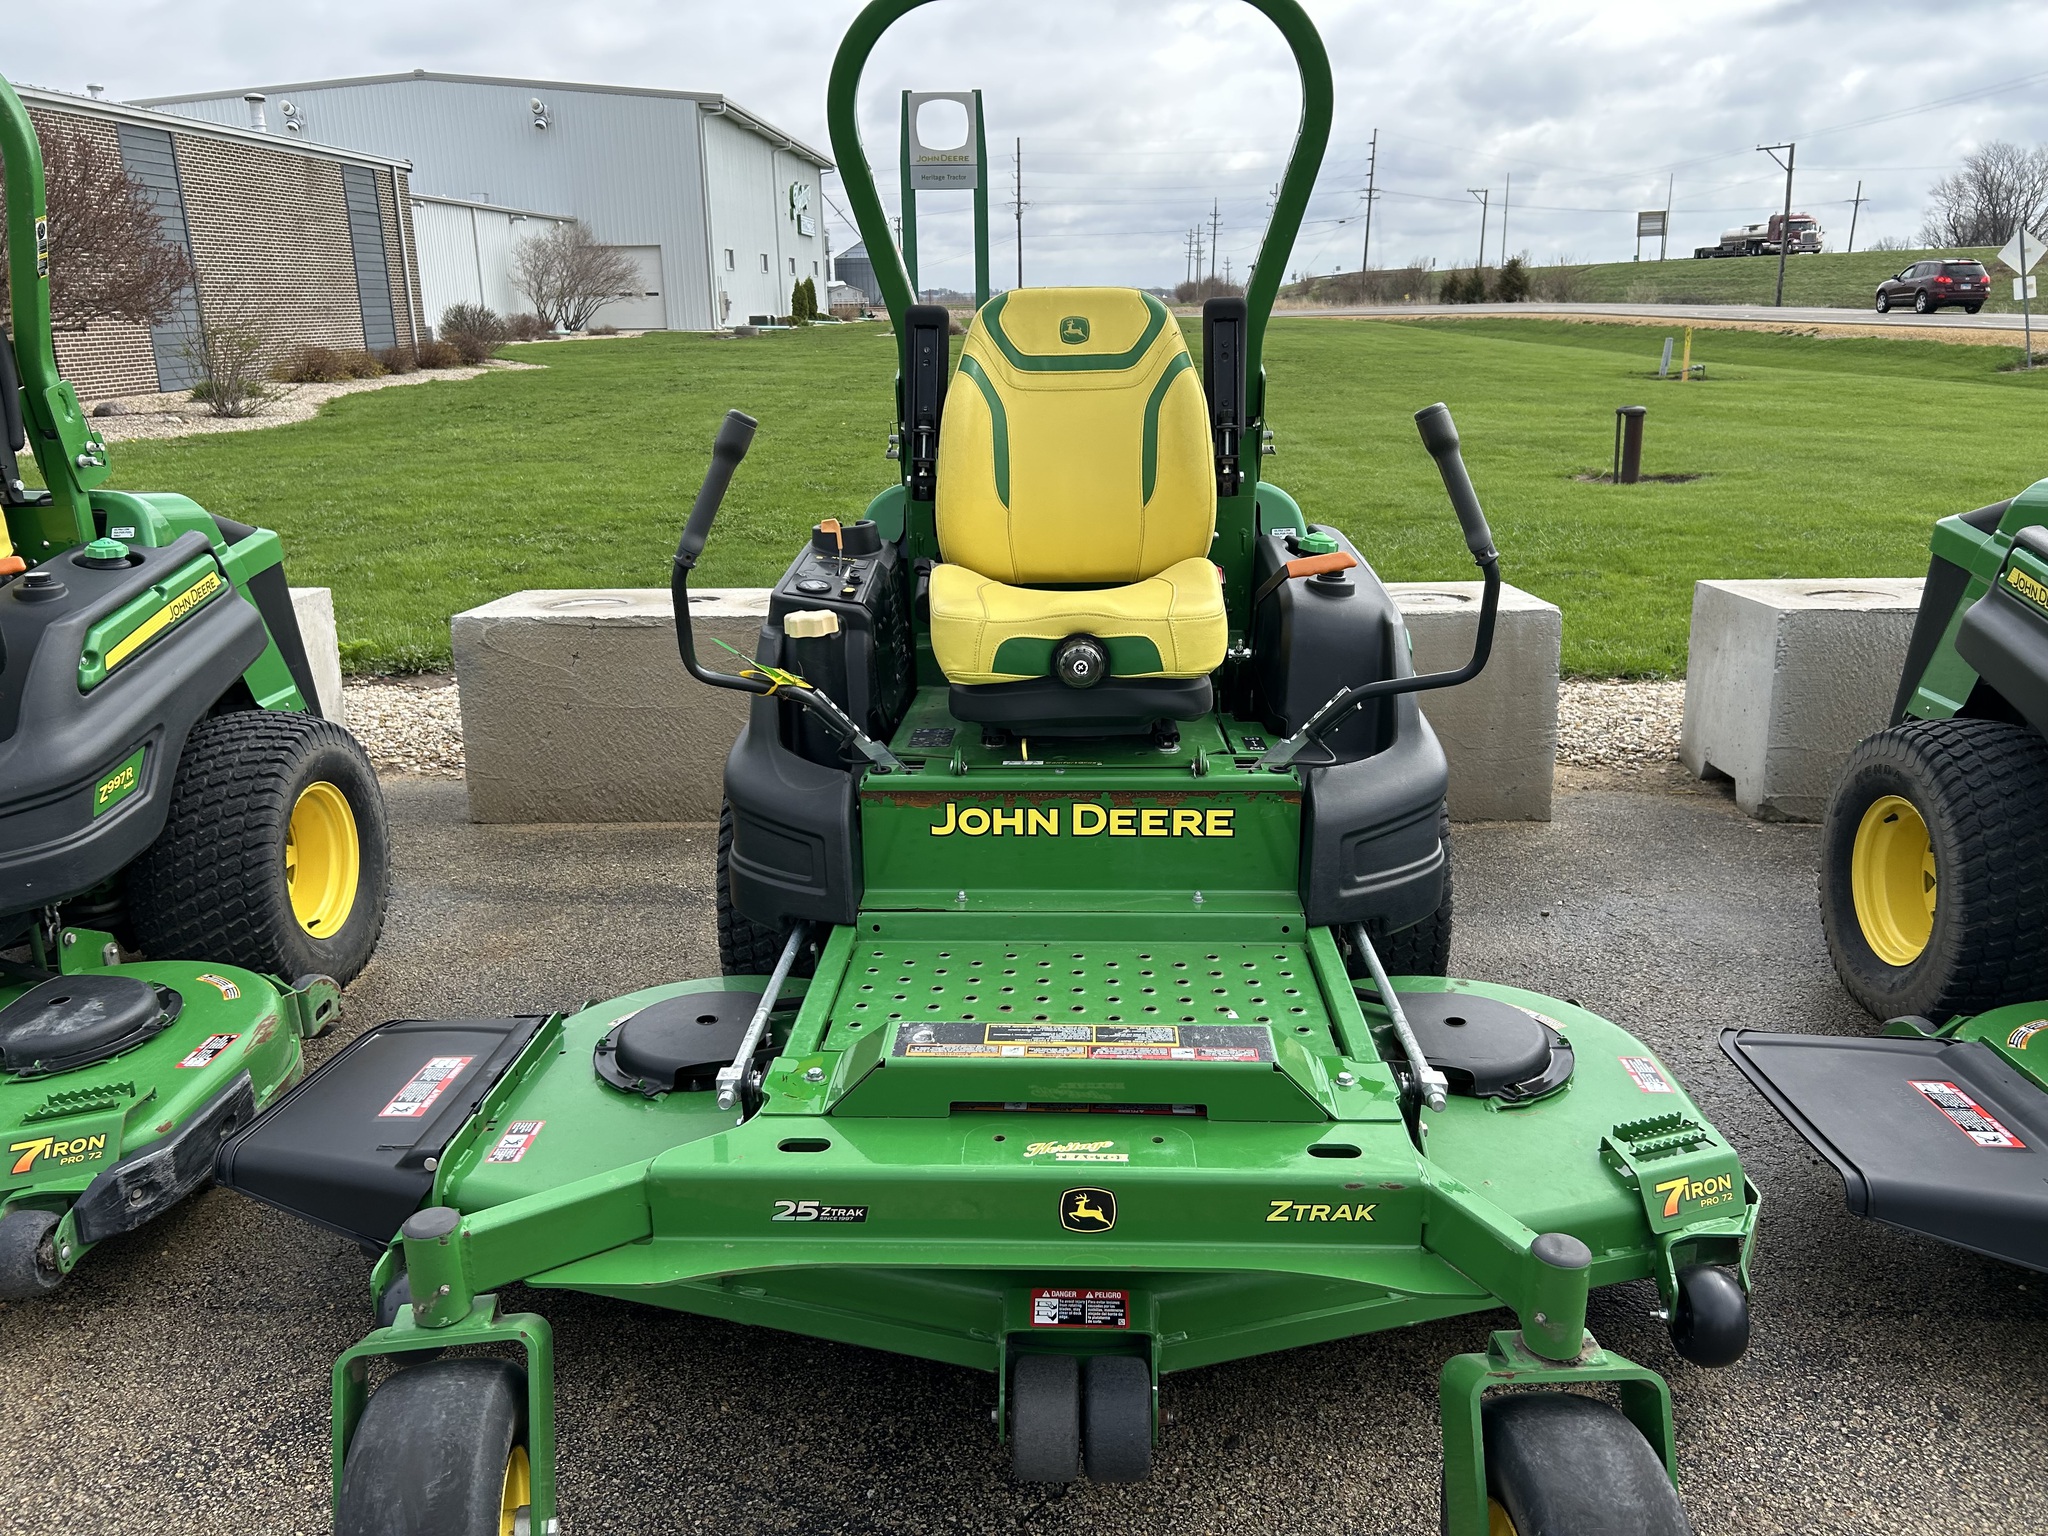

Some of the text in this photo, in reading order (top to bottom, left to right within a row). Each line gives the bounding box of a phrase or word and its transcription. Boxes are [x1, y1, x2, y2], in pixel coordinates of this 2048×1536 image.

[941, 154, 970, 162] DEERE
[2014, 573, 2038, 599] JOHN
[169, 577, 216, 620] JOHN DEERE
[99, 766, 133, 804] Z997R
[930, 801, 1236, 838] JOHN DEERE
[59, 1151, 102, 1166] PRO 72
[771, 1200, 865, 1221] 25 ZTRAK
[1265, 1199, 1378, 1222] ZTRAK
[1700, 1192, 1733, 1208] PRO 72
[1051, 1290, 1077, 1298] DANGER
[1094, 1291, 1122, 1299] PELIGRO
